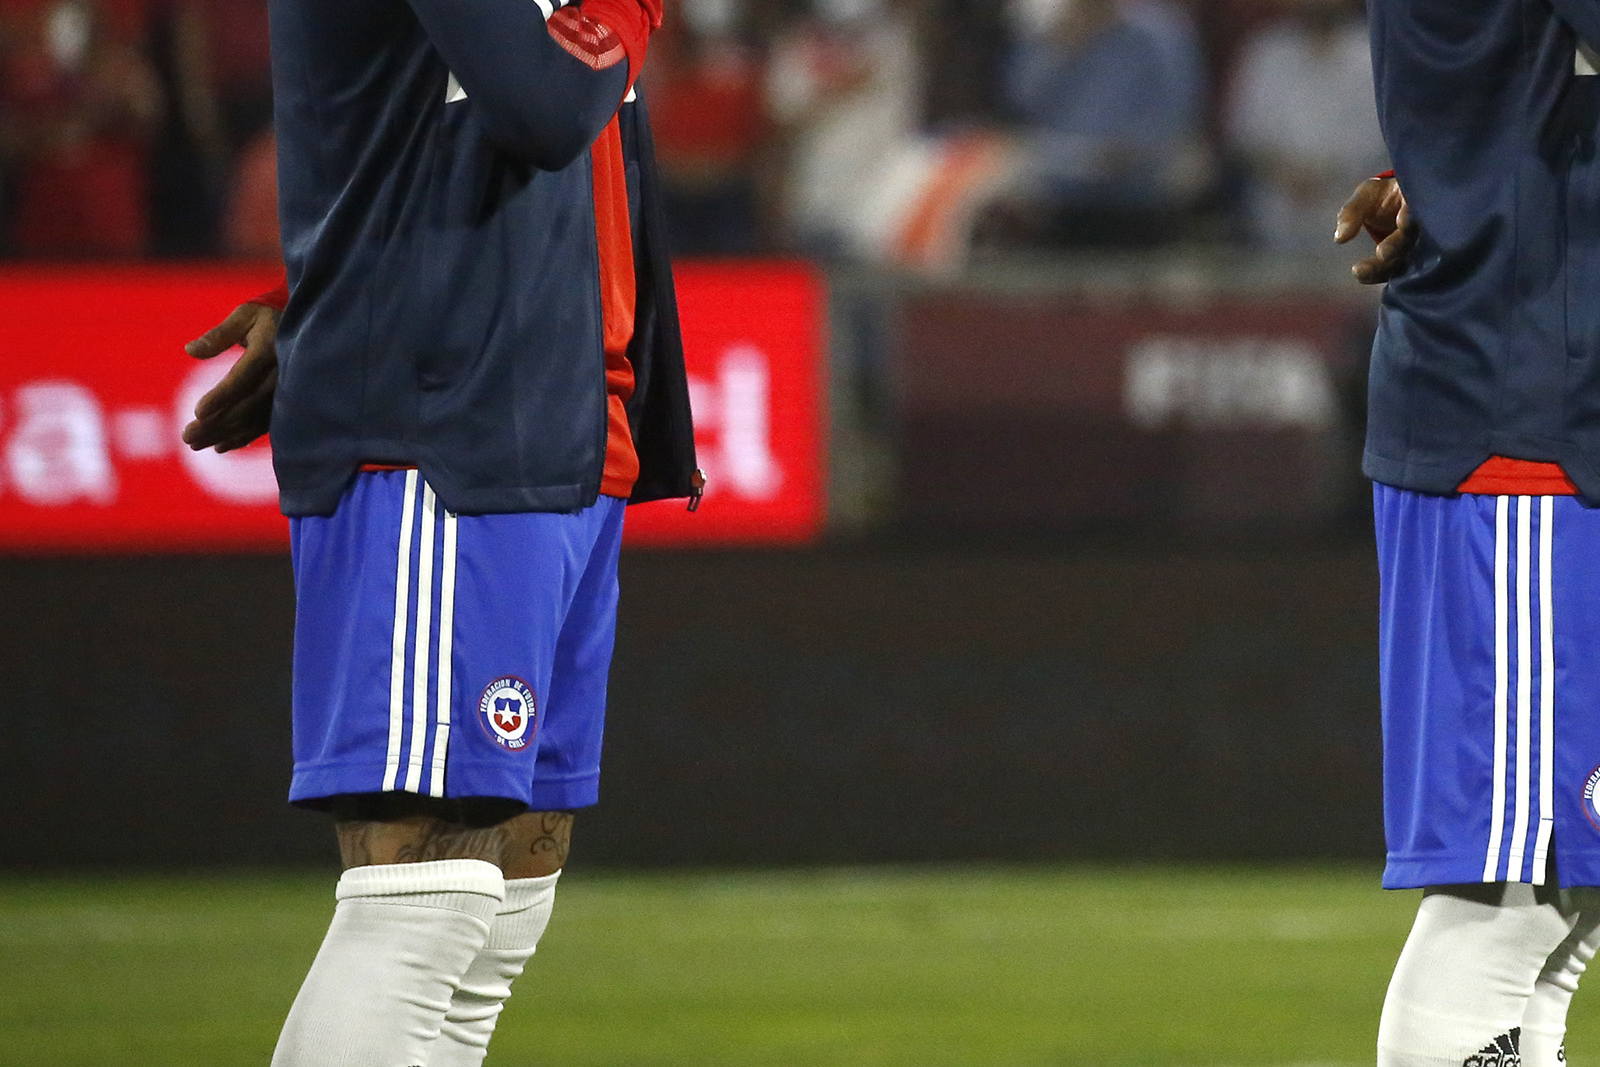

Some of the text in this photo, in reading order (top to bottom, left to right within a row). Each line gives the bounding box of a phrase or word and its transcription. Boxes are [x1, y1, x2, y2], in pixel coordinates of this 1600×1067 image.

[480, 679, 511, 712] FEDERACION
[514, 680, 523, 691] DE
[496, 735, 506, 746] DE
